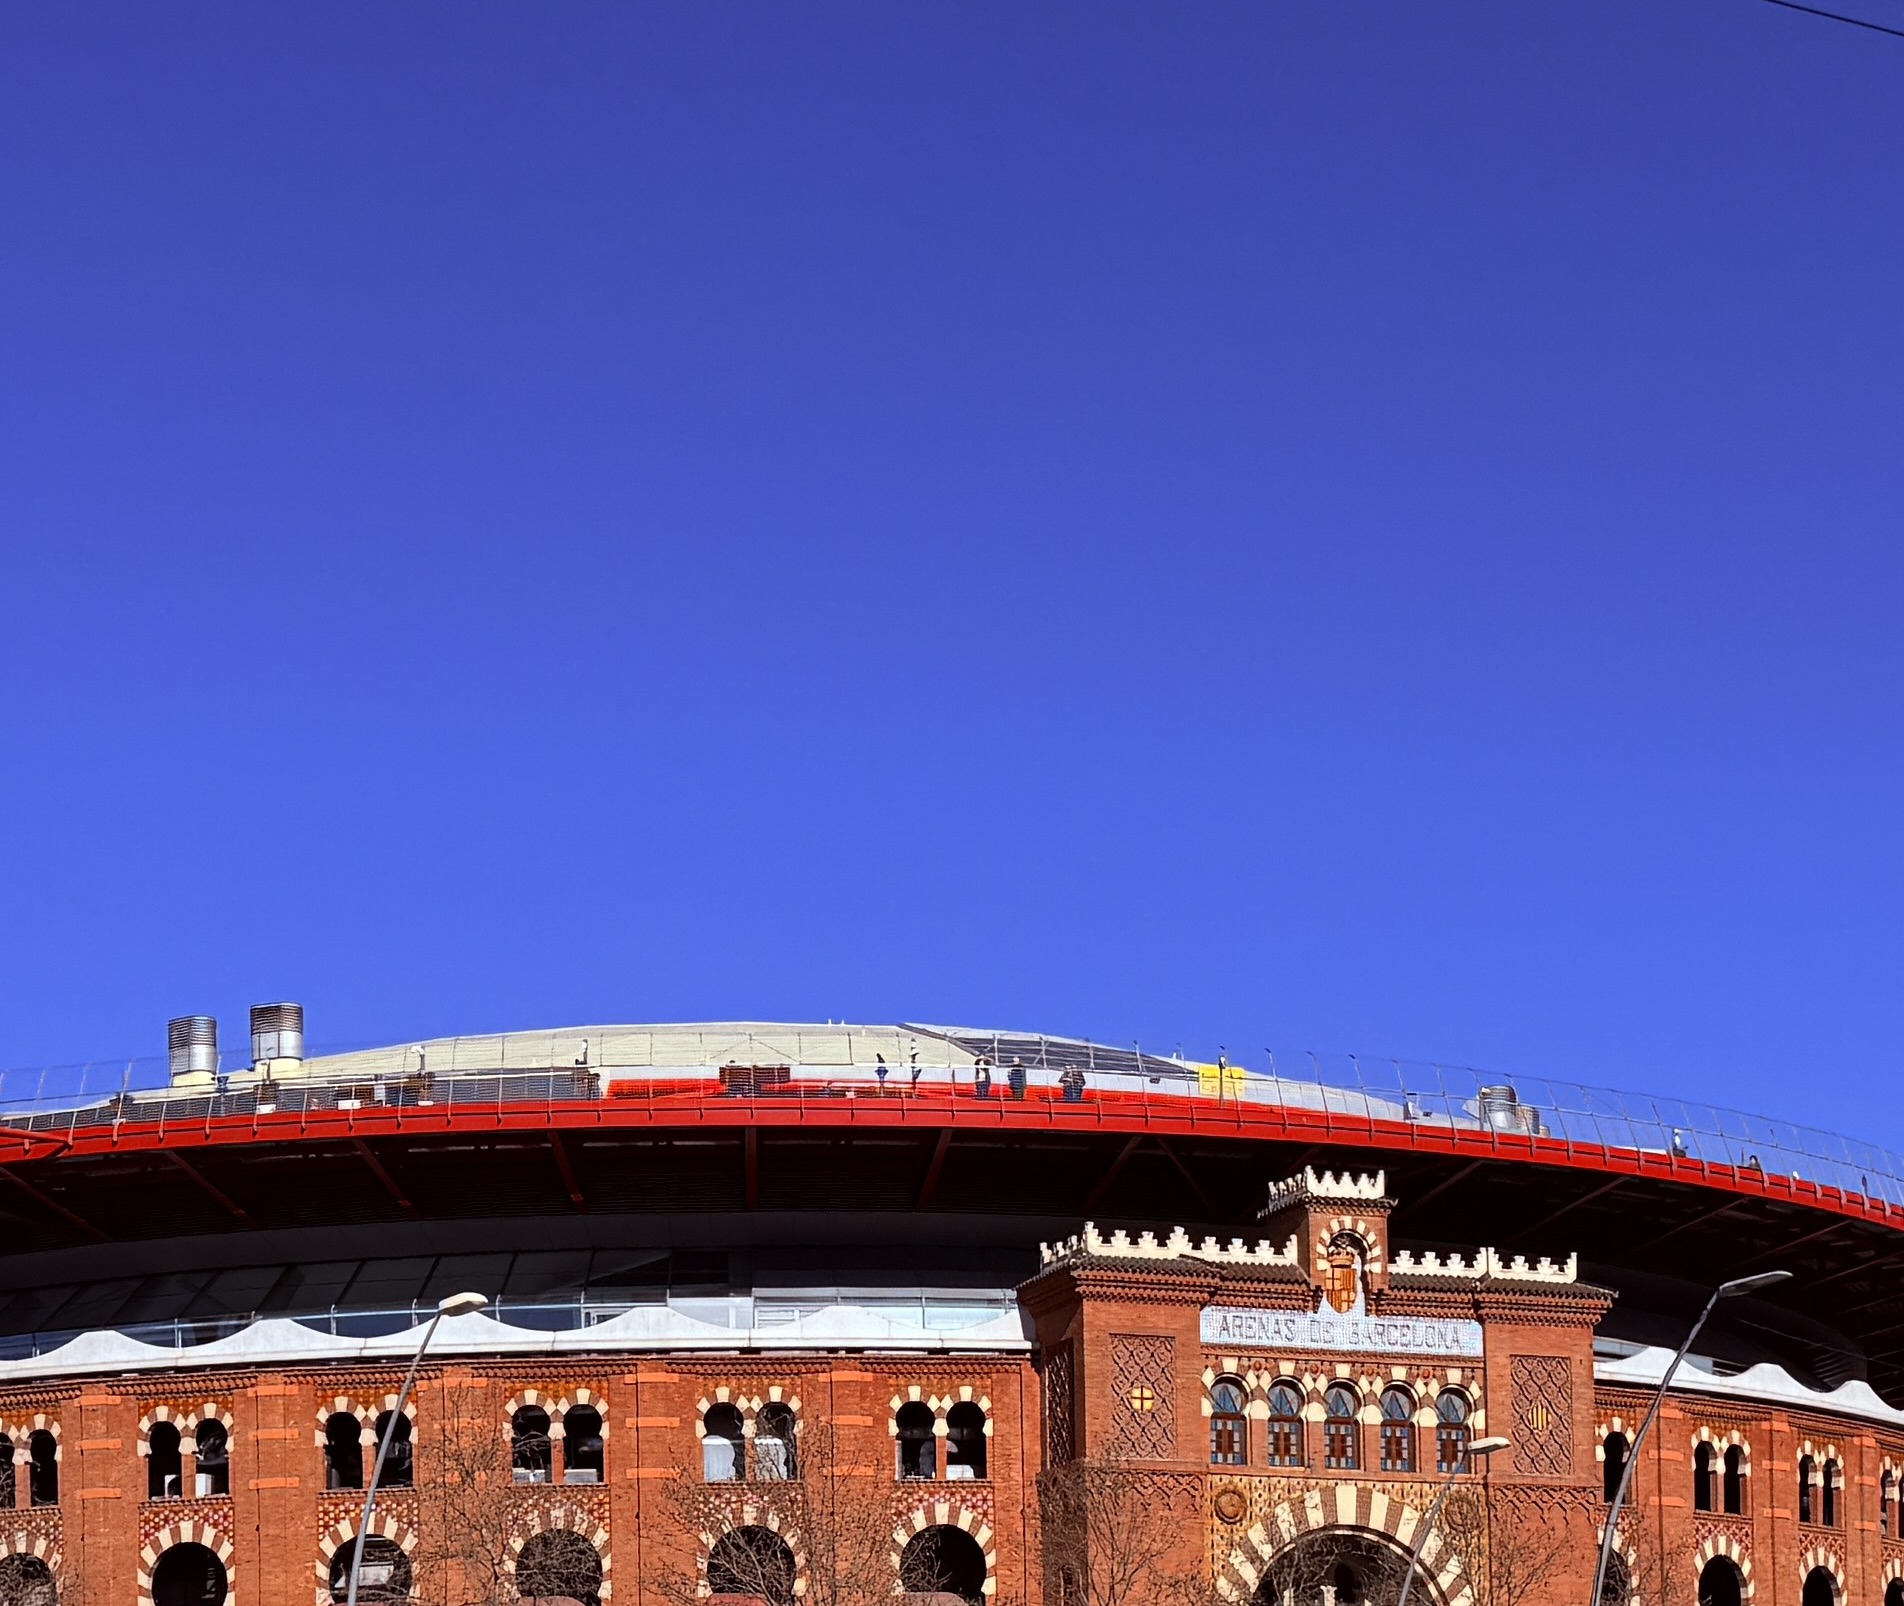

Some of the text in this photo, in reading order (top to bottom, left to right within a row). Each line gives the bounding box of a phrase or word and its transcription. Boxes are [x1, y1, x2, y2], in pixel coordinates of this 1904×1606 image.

[1218, 1315, 1464, 1349] ARENAS DE BARCELONA
